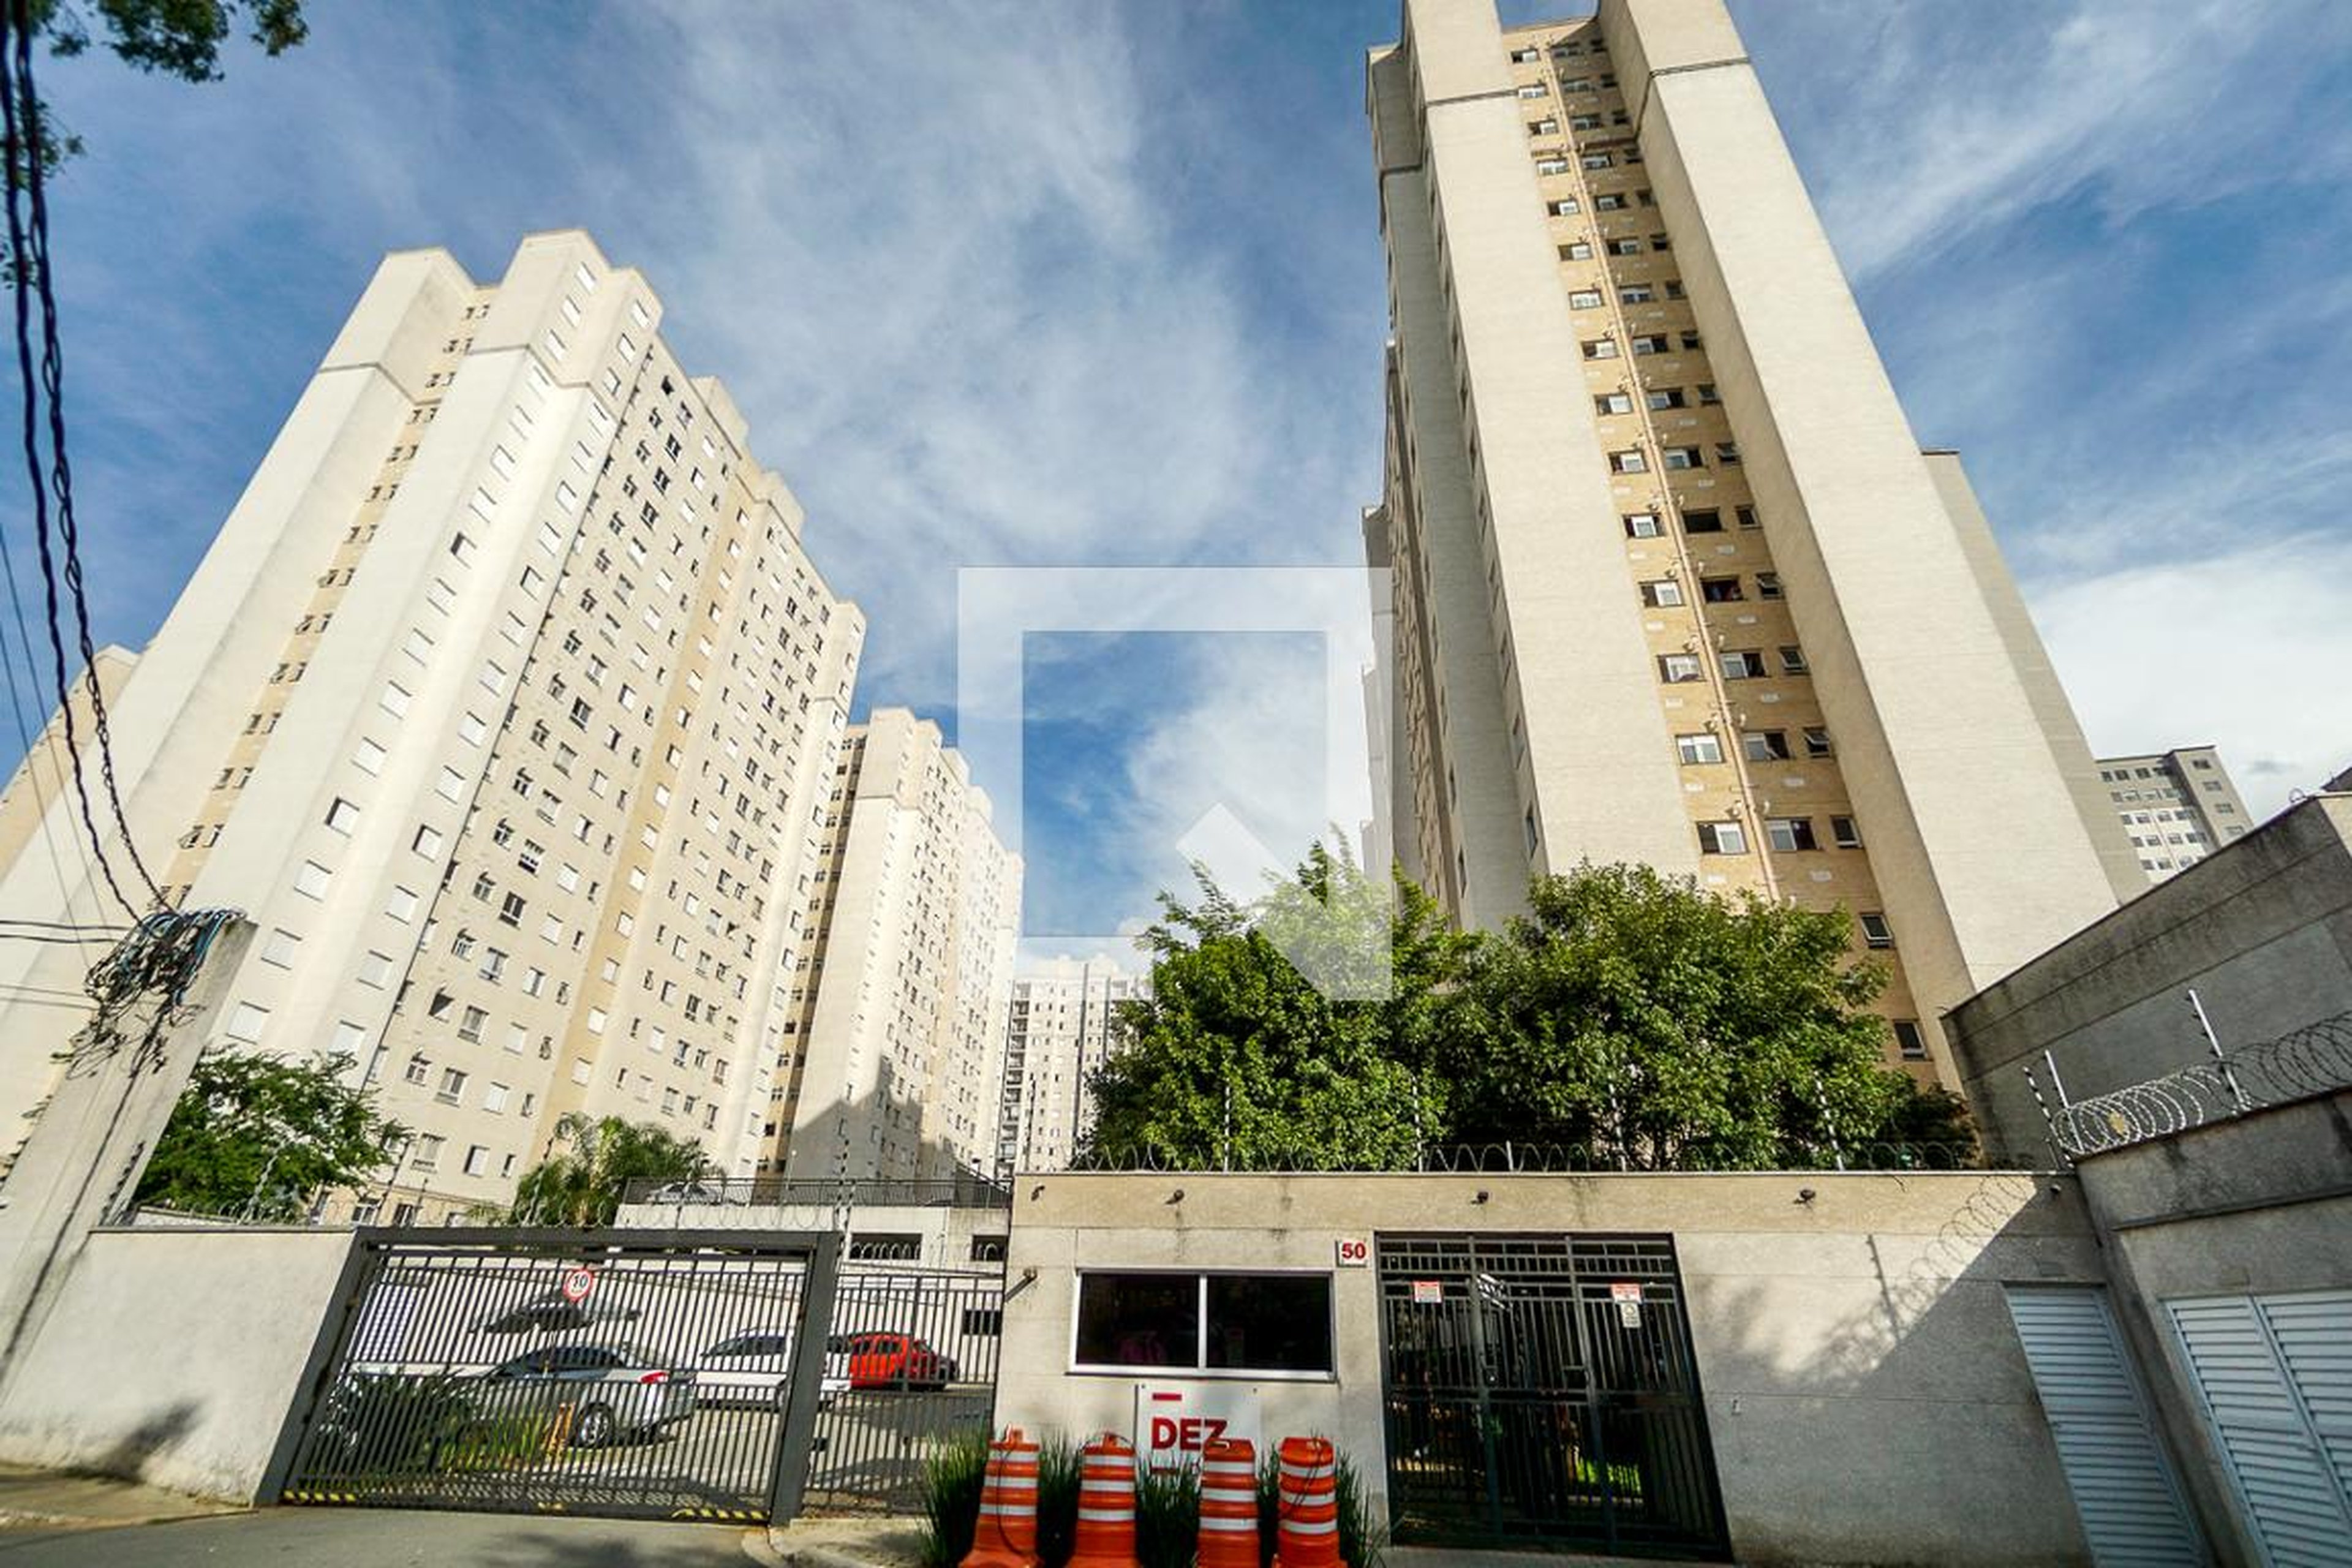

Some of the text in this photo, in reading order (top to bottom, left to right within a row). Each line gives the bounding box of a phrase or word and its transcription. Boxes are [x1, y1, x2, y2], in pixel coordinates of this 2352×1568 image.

[1341, 1243, 1366, 1259] 50
[573, 1274, 589, 1288] 10
[1152, 1417, 1228, 1451] DEZ
